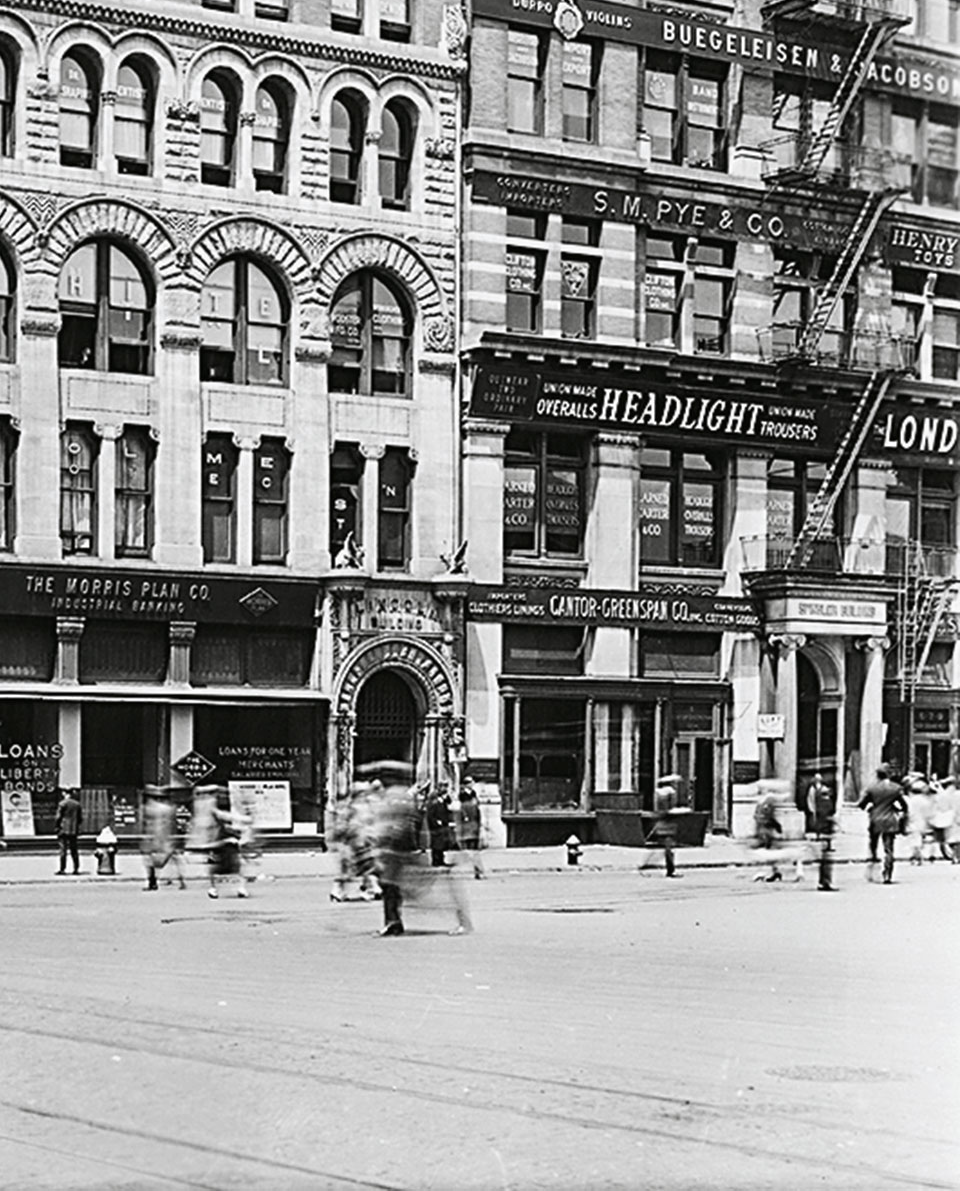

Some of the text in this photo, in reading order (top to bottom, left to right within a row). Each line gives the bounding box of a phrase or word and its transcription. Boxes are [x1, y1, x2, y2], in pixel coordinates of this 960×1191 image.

[585, 9, 632, 29] VIOLINS
[662, 19, 818, 69] BUEGELEISEN
[830, 54, 843, 74] &
[496, 176, 571, 196] CONVERTERS
[656, 200, 707, 226] PYE
[719, 210, 734, 230] &
[746, 213, 789, 239] CO.
[892, 228, 959, 254] HENRY
[914, 248, 954, 267] TOYS
[543, 382, 598, 399] UNION MADE
[536, 398, 598, 420] OVERALLS
[598, 387, 764, 436] HEADLIGHT
[768, 404, 817, 421] UNION MADE
[760, 420, 818, 441] TROUSERS
[25, 575, 211, 601] THE MORRIS PLAN CO.
[51, 596, 185, 614] INDUSTRIAL BANKING
[218, 746, 312, 757] LOANS FOR ONE YEAR
[0, 767, 61, 780] LIBERTY
[239, 759, 296, 770] MERCHANTS
[4, 781, 56, 793] BONDS
